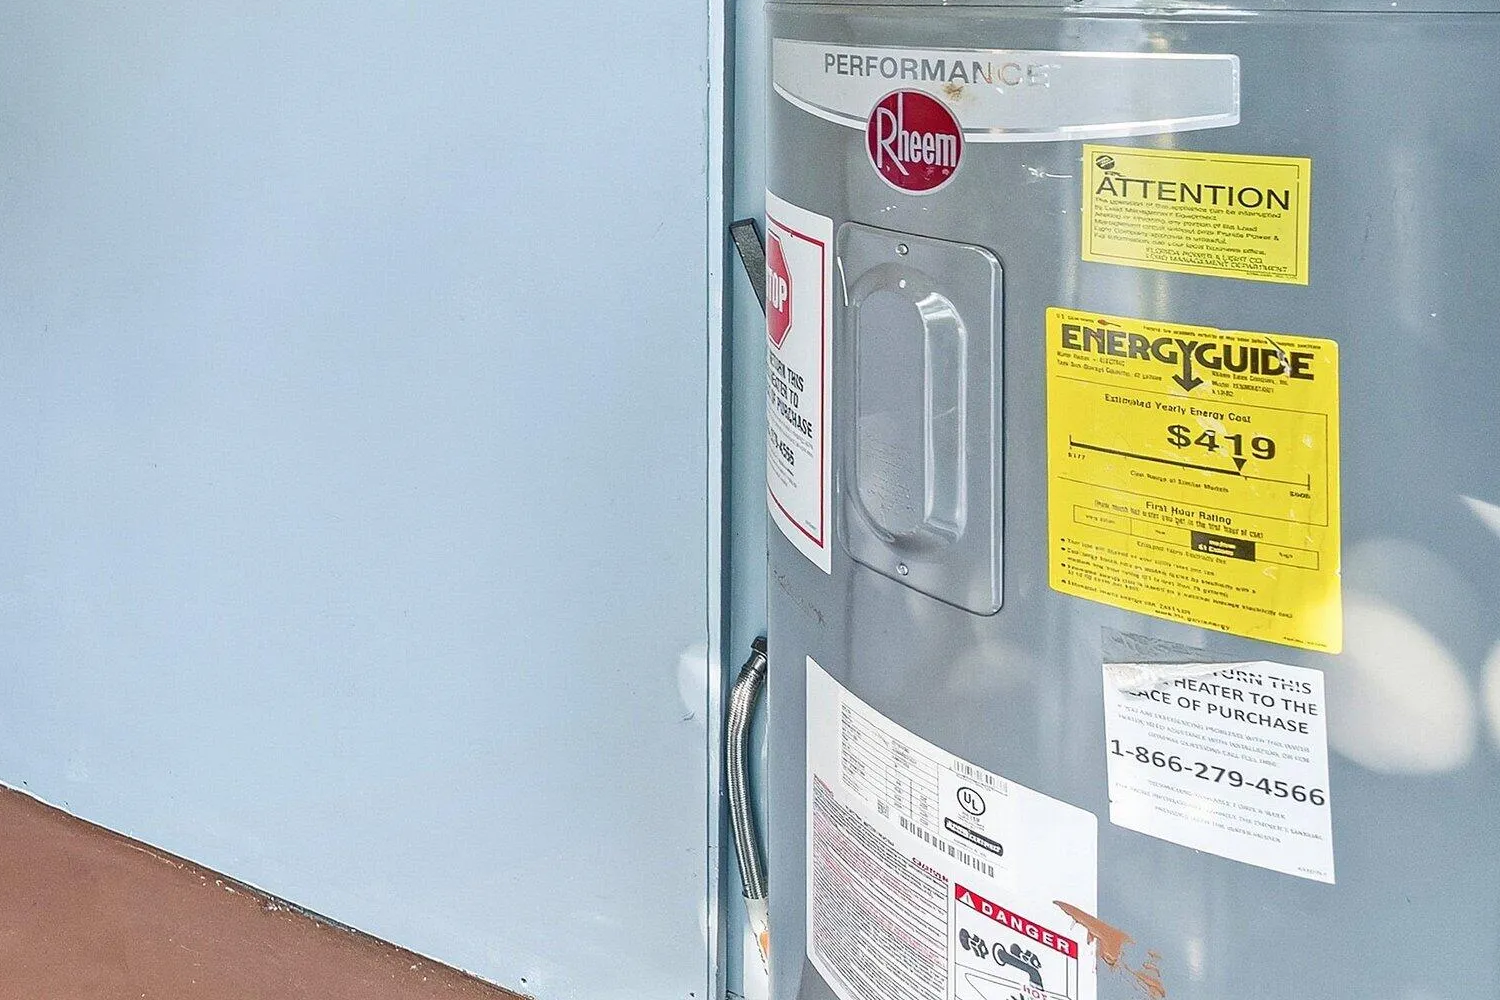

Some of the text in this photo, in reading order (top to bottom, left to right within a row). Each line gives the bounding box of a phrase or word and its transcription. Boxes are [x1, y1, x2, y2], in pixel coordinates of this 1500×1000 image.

[876, 92, 956, 176] Rheem
[1095, 177, 1290, 211] ATTENTION
[766, 266, 788, 313] TOP
[1061, 322, 1315, 383] ENERGYGUIDE
[1104, 393, 1252, 424] Estimated Yearly Energy Cost
[1166, 424, 1277, 462] $419
[1145, 500, 1232, 526] First Hour Rating
[1174, 678, 1319, 716] HEATER TO THE
[1268, 674, 1312, 695] THIS
[1177, 696, 1201, 711] OF
[1207, 702, 1309, 735] PURCHASE
[1111, 739, 1326, 806] 1-866-279-4566
[981, 903, 1071, 954] DANGER
